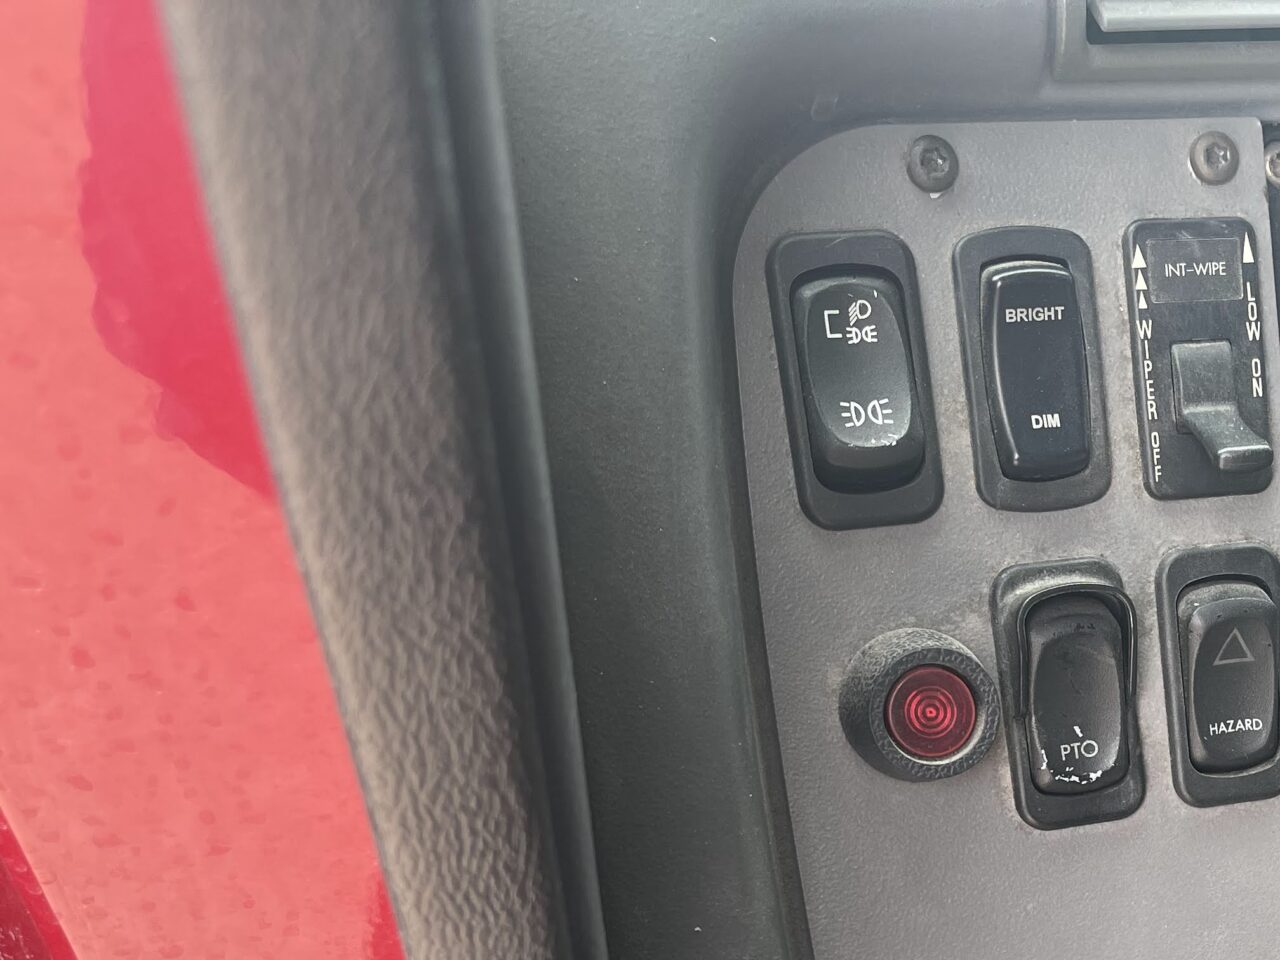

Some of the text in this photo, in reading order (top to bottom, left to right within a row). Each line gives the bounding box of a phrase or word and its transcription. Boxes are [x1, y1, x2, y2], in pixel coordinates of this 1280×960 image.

[1164, 261, 1227, 279] INT-WIPE
[1004, 305, 1065, 324] BRIGHT
[1244, 281, 1264, 398] LOW ON
[1135, 319, 1163, 483] WIPER OFF
[1030, 413, 1062, 430] DIM
[1208, 717, 1264, 736] HAZARD
[1059, 739, 1100, 762] PTO
